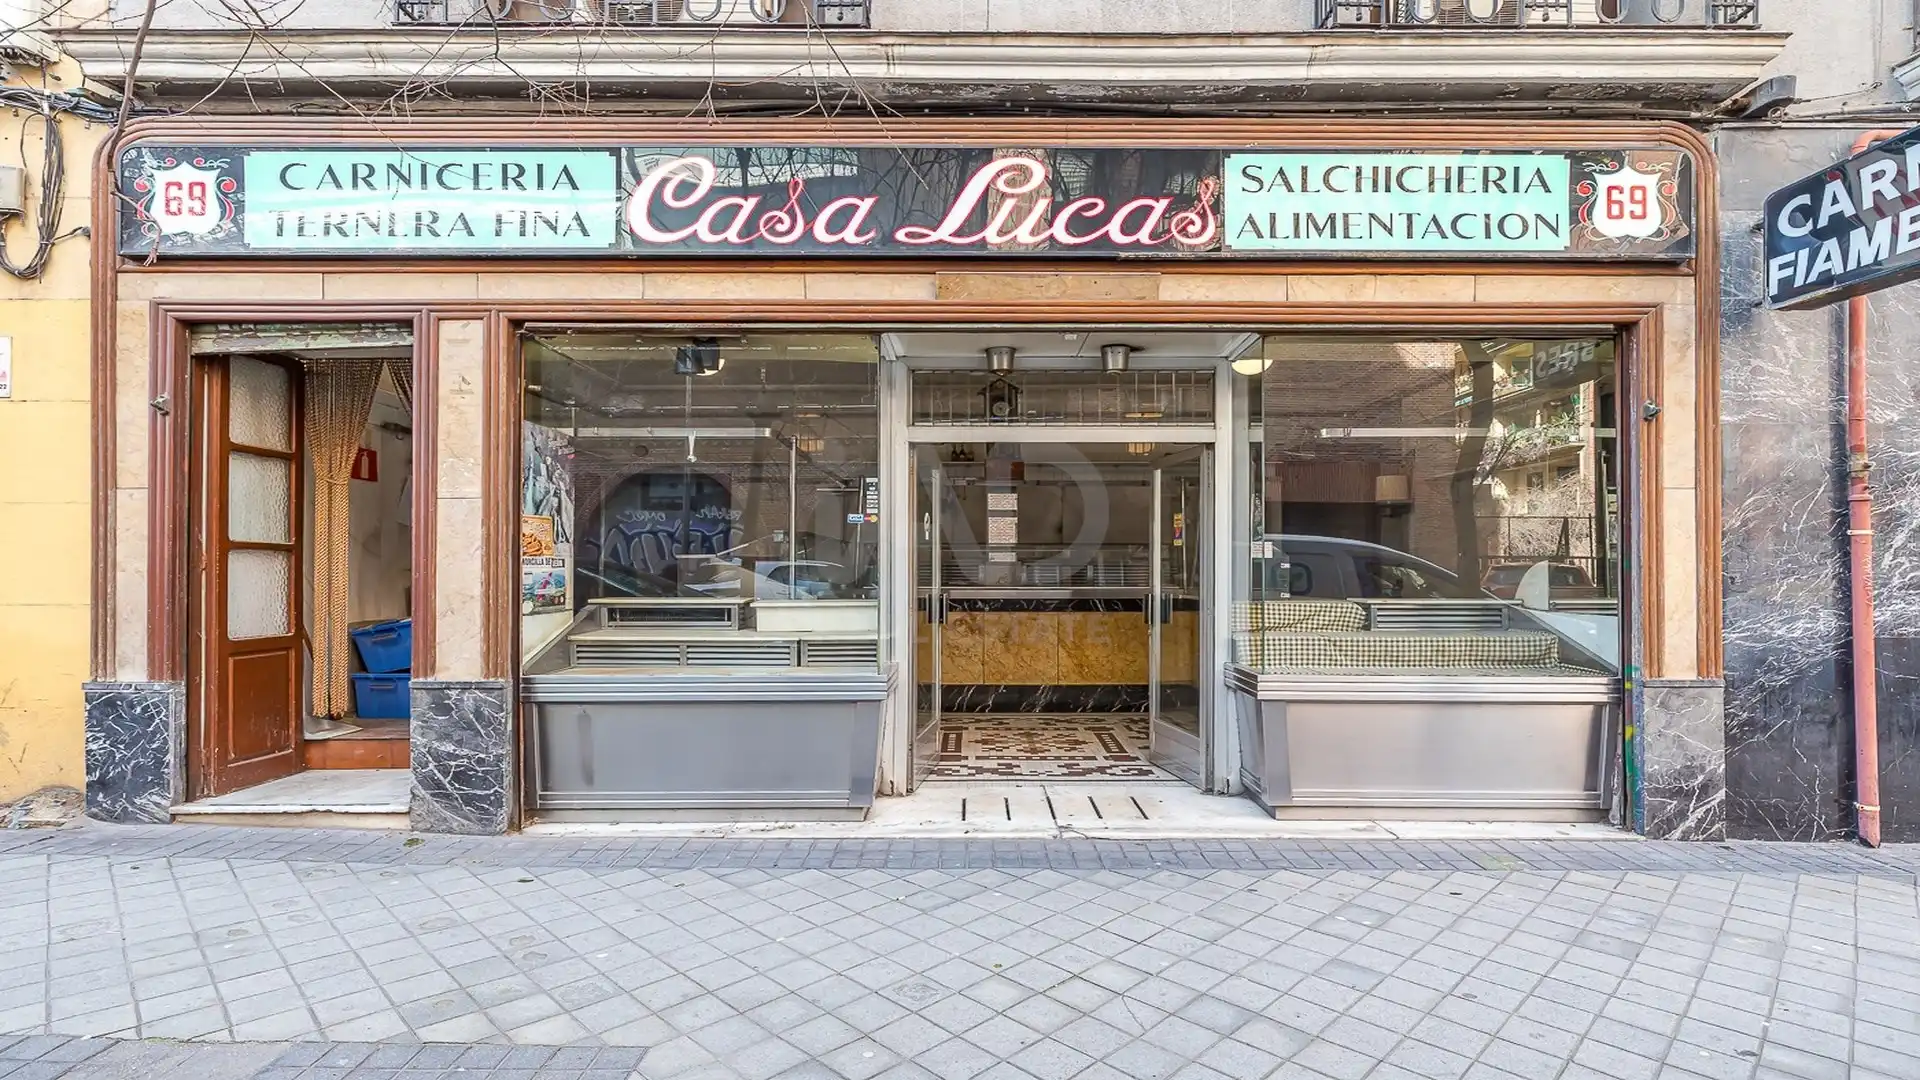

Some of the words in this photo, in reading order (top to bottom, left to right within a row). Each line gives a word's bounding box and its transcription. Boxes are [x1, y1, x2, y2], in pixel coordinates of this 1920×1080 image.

[279, 162, 580, 191] CARNICERIA
[1241, 164, 1553, 194] SALCHICHERIA
[165, 181, 207, 216] 69
[627, 156, 878, 246] Casa
[893, 155, 1217, 247] Lucas
[1605, 184, 1648, 220] 69
[494, 209, 591, 238] FINA
[1236, 211, 1561, 240] ALIMENTACION
